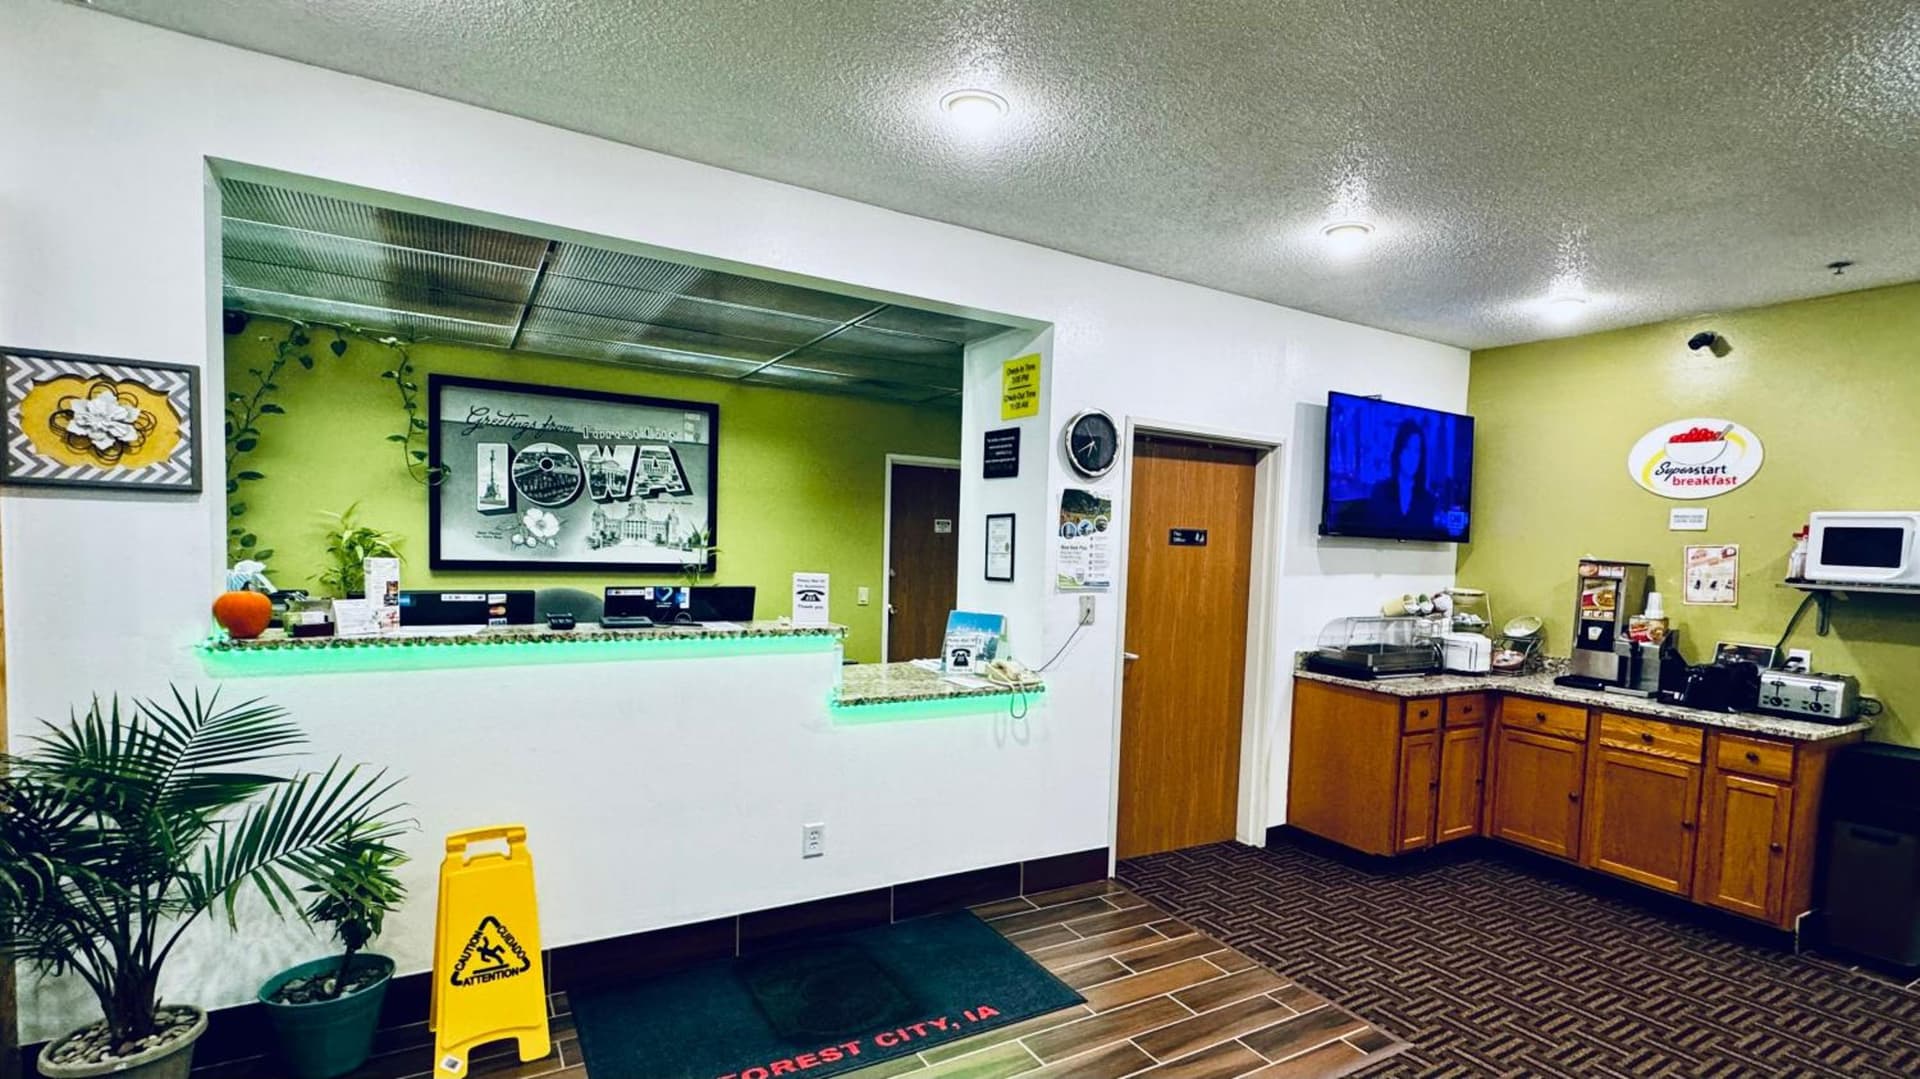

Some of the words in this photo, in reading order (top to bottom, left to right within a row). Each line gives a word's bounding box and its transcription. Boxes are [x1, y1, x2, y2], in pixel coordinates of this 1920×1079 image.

[461, 405, 536, 440] Greetings
[534, 414, 574, 439] from
[477, 442, 692, 512] IOWA
[1655, 461, 1727, 481] Superstart
[1672, 475, 1737, 486] breakfast
[454, 930, 483, 971] CAUTION
[497, 925, 526, 959] CUIDADO
[463, 967, 519, 987] ATTENTION
[716, 1040, 860, 1079] OREST
[874, 1016, 961, 1047] CITY,
[963, 1004, 1000, 1022] IA
